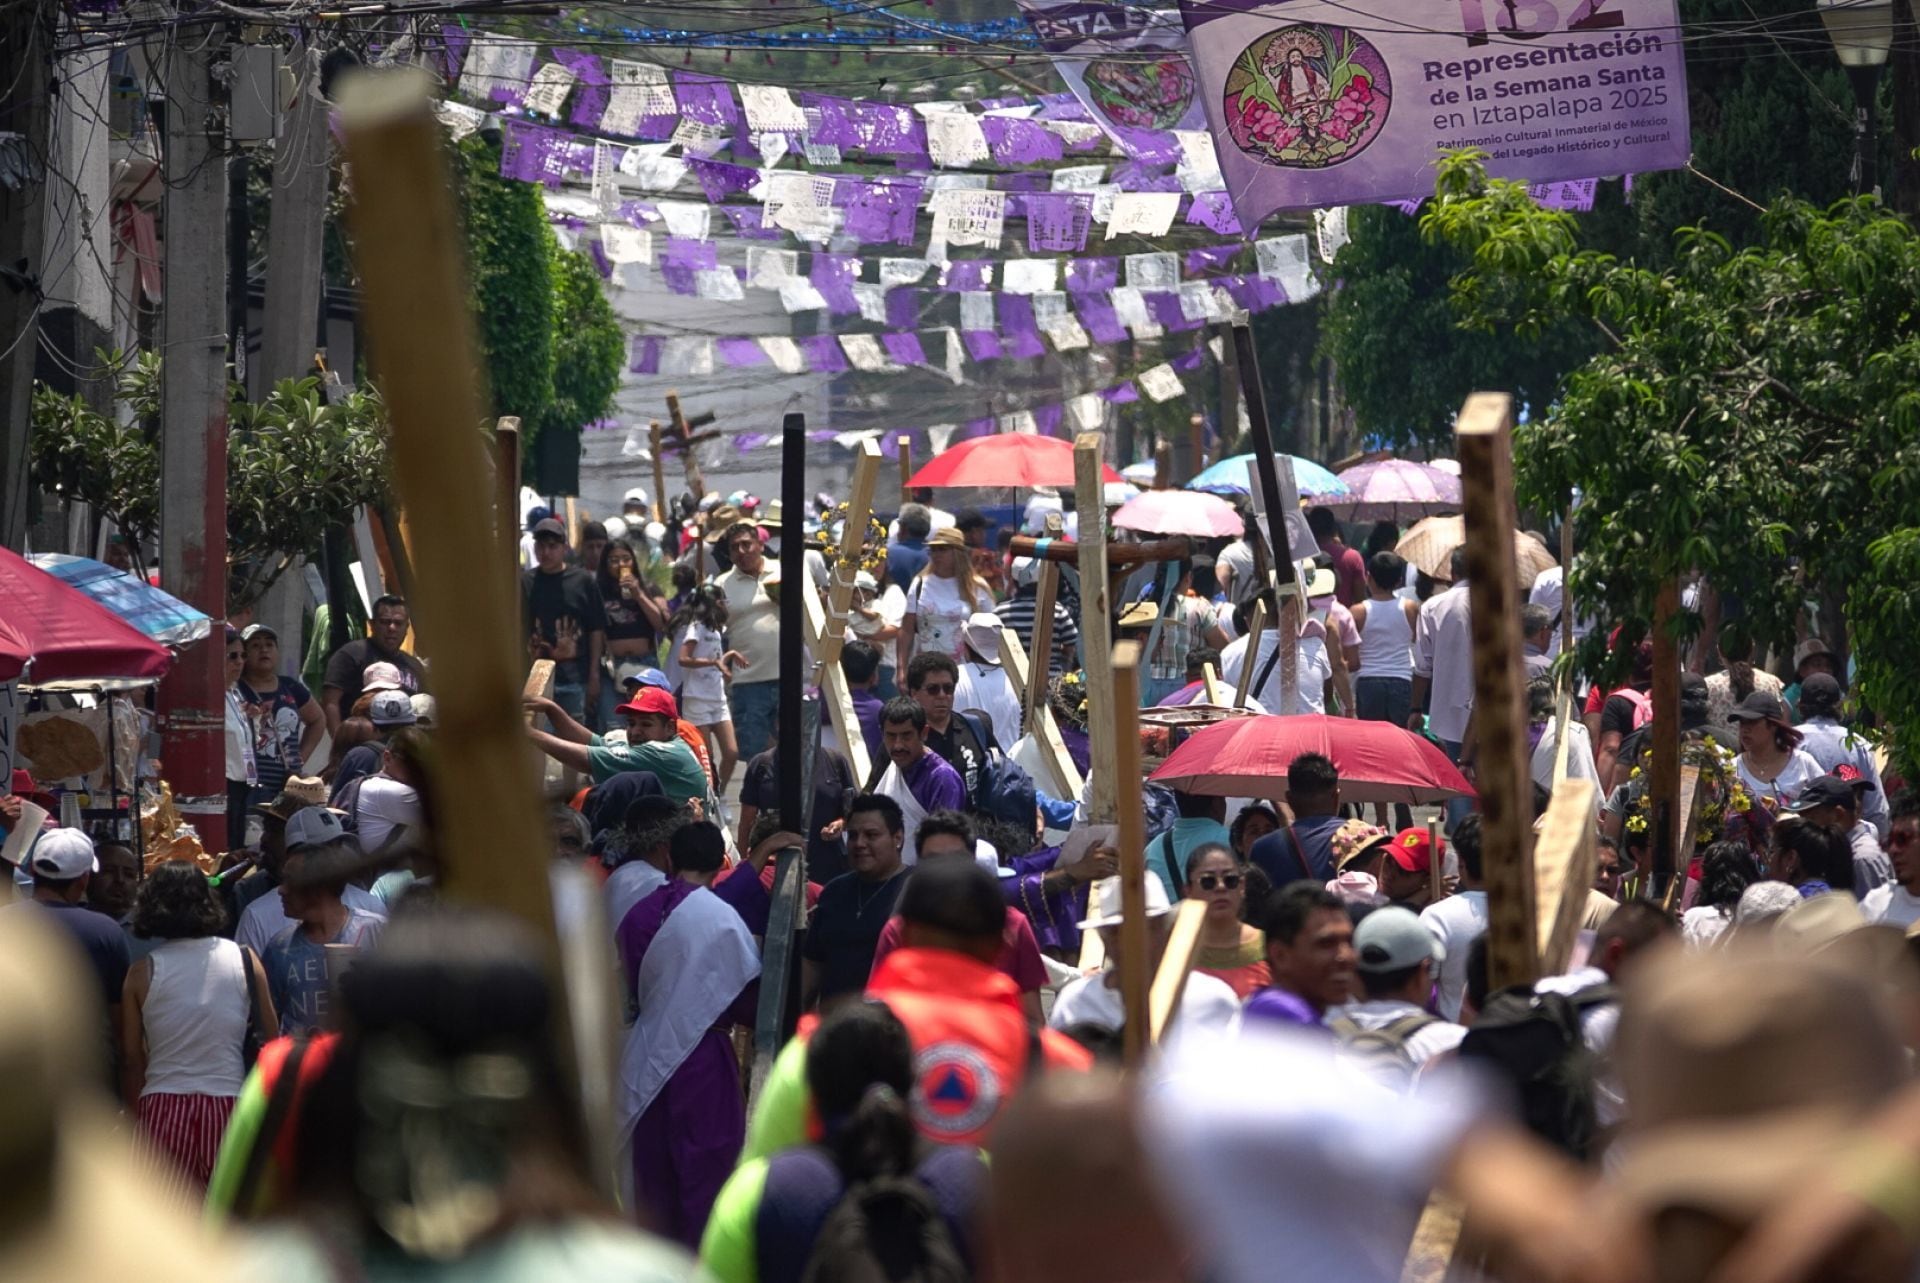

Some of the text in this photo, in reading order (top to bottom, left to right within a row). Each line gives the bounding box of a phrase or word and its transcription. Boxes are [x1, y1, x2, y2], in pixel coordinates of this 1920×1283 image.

[1423, 32, 1662, 82] Representación
[1430, 65, 1666, 106] de la Semana Santa
[1433, 86, 1668, 130] en Iztapalapa 2025
[1437, 115, 1668, 149] Patrimonio Cultural Inmaterial de México
[1492, 148, 1511, 160] del
[1513, 144, 1555, 159] Legado
[1557, 138, 1611, 153] Histórico
[1613, 138, 1621, 149] y
[1623, 131, 1671, 146] Cultural
